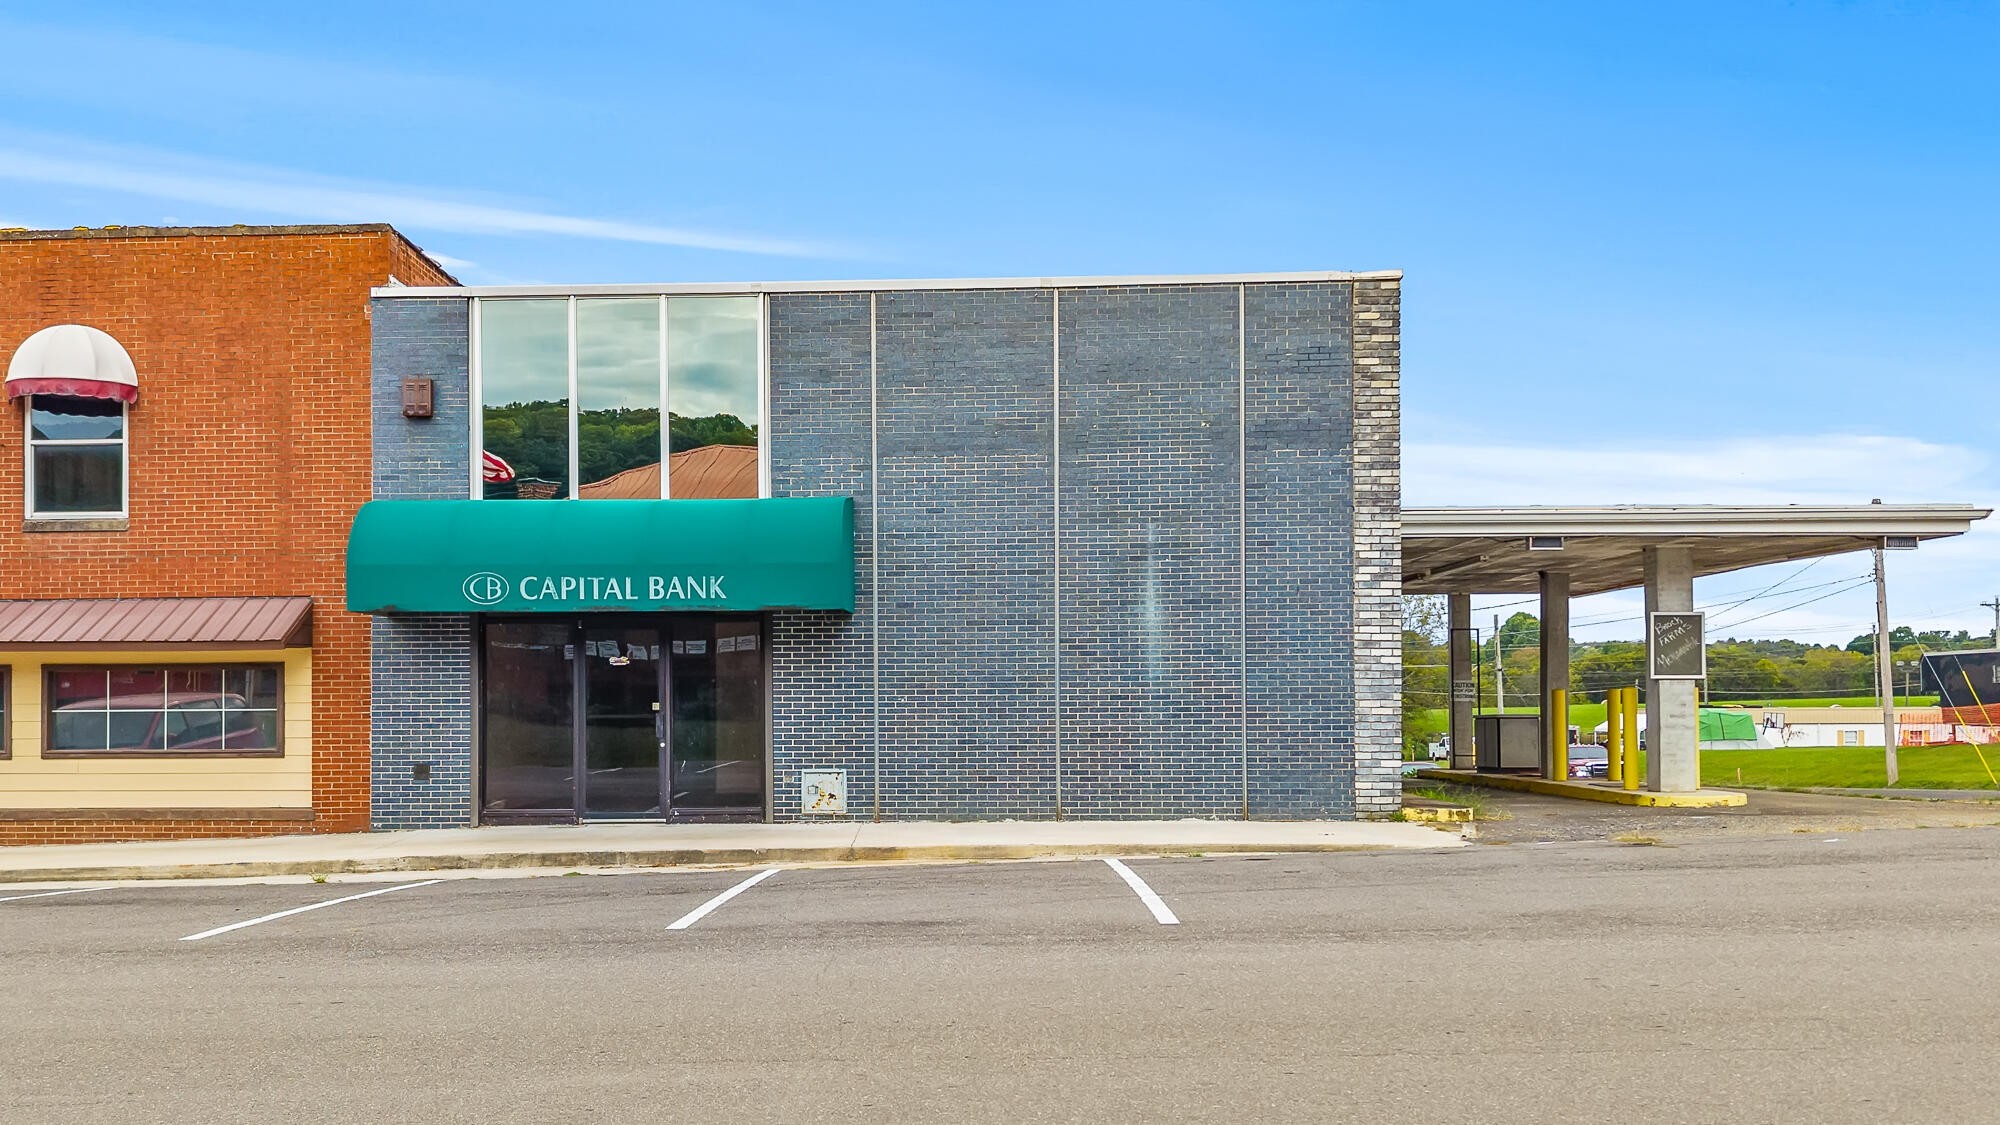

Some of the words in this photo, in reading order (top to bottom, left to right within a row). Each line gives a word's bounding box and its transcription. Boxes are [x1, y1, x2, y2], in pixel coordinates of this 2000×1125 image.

[468, 575, 502, 601] CB
[519, 576, 638, 600] CAPITAL
[649, 576, 727, 599] BANK
